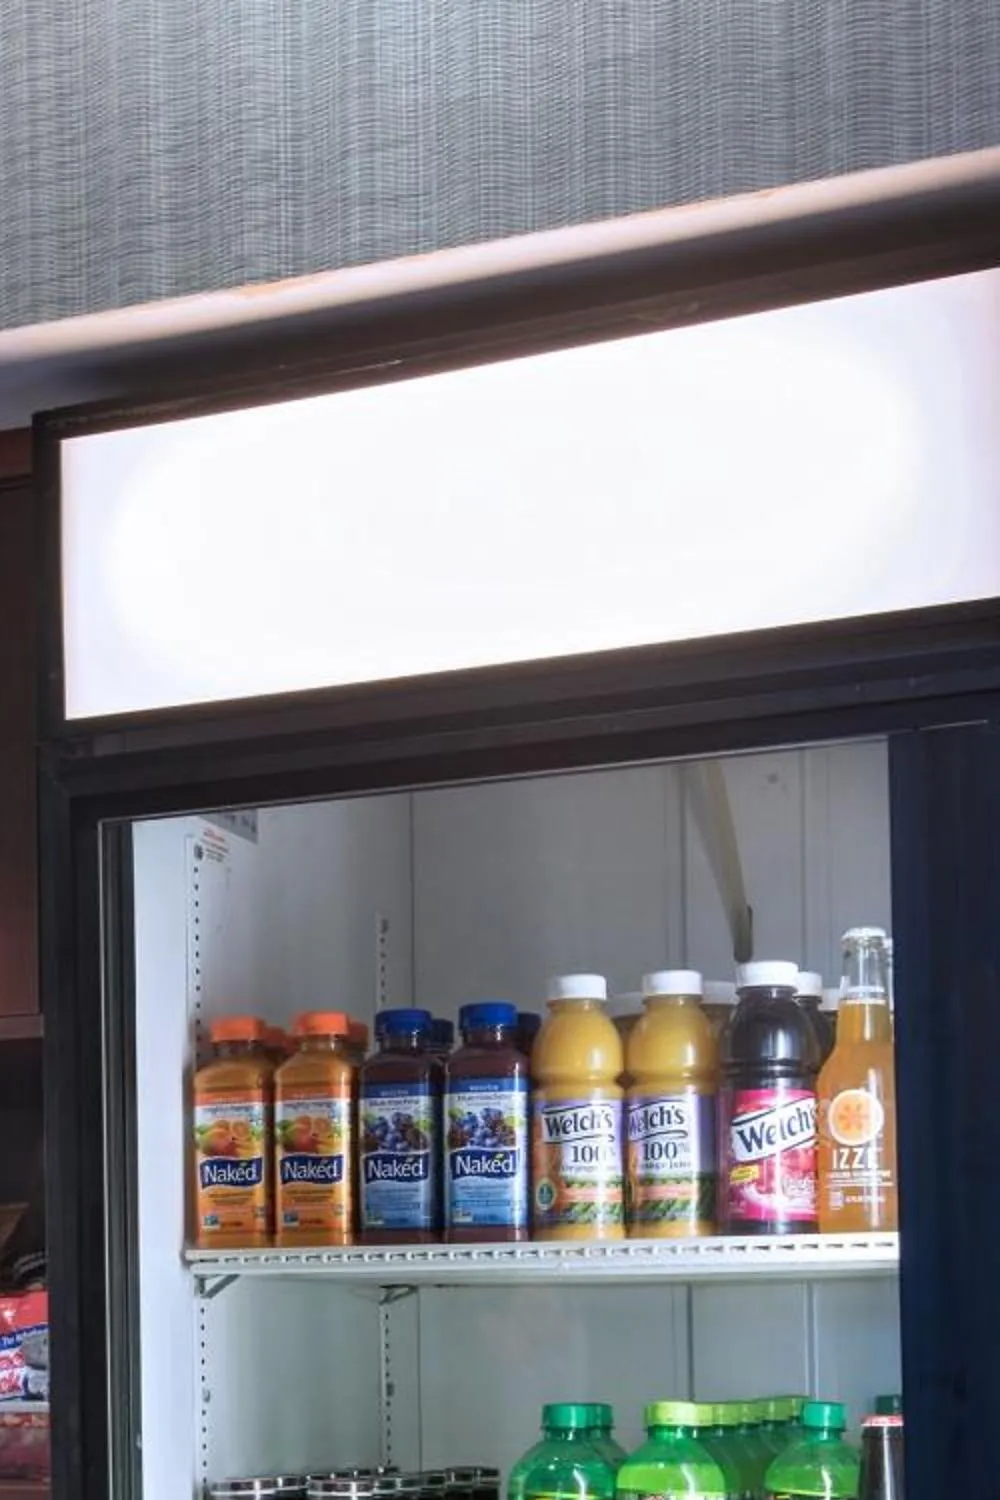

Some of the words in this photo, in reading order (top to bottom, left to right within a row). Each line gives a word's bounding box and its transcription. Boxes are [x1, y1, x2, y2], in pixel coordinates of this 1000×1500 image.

[204, 1163, 257, 1183] Naked
[285, 1160, 338, 1179] Naked
[367, 1158, 424, 1178] Naked
[455, 1154, 515, 1175] Naked
